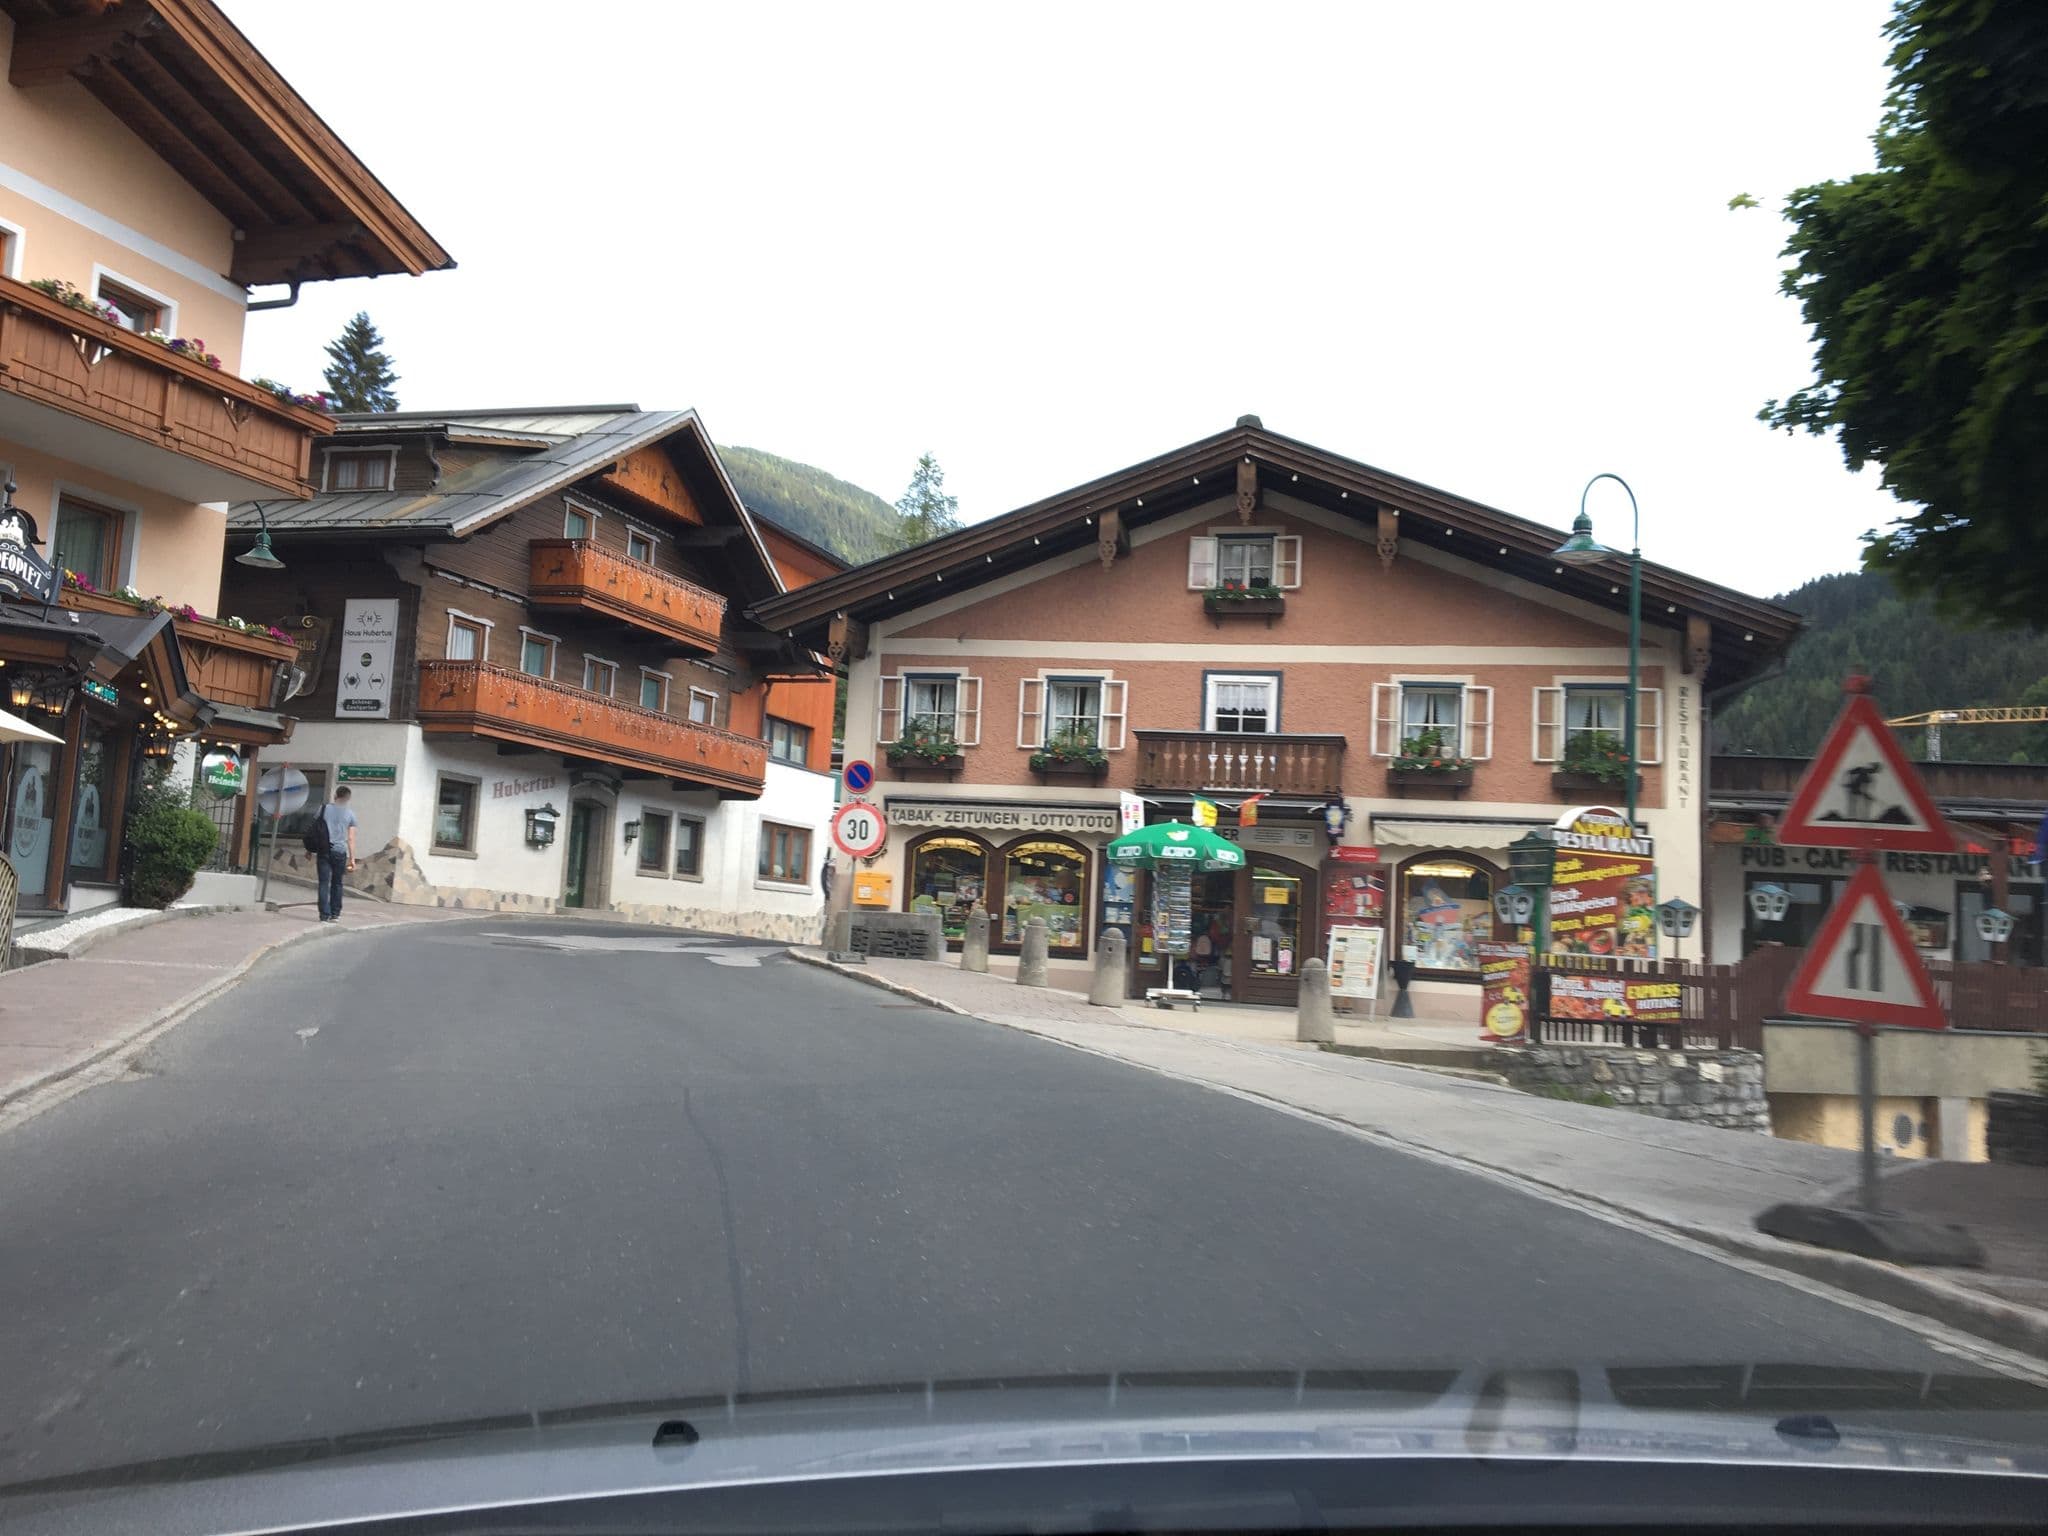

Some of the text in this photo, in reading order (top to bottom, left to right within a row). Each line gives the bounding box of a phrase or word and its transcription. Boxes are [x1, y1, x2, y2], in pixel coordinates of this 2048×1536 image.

[0, 551, 42, 590] EOPLE'Z
[1679, 686, 1689, 808] RESTAURANT
[493, 776, 556, 799] Hubertus
[892, 808, 933, 822] TABAK
[944, 810, 1020, 825] ZEITUNGEN
[1031, 813, 1074, 827] LOTTO
[1077, 814, 1113, 828] TOTO
[847, 819, 868, 840] 30
[1742, 847, 1785, 867] PUB
[1806, 848, 1852, 869] CAF
